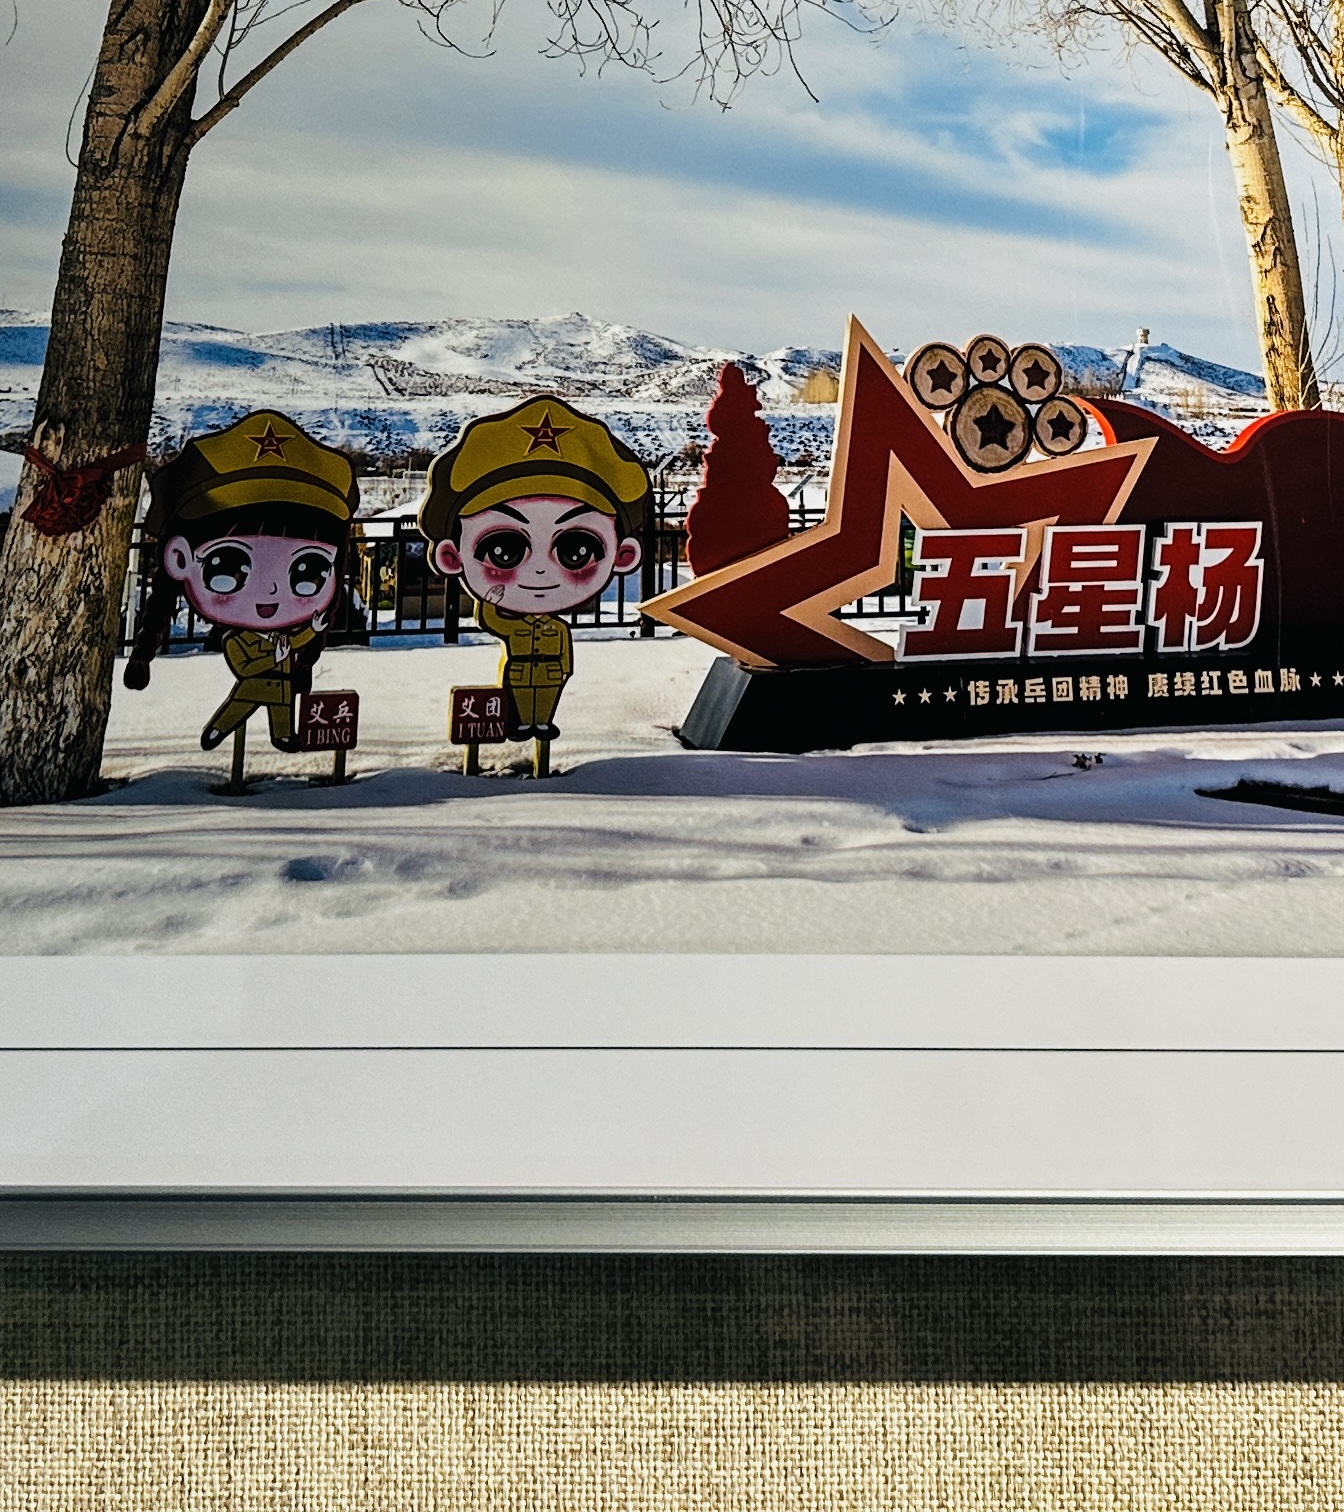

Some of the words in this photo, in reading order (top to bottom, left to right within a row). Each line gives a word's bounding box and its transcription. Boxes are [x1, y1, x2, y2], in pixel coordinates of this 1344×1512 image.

[895, 522, 1264, 662] 五星杨
[967, 674, 1129, 706] 传承兵团精神
[1147, 668, 1301, 698] 赓续红色血脉
[307, 729, 311, 745] I
[317, 728, 350, 744] BING
[459, 723, 463, 738] I
[468, 722, 504, 738] TUAN
